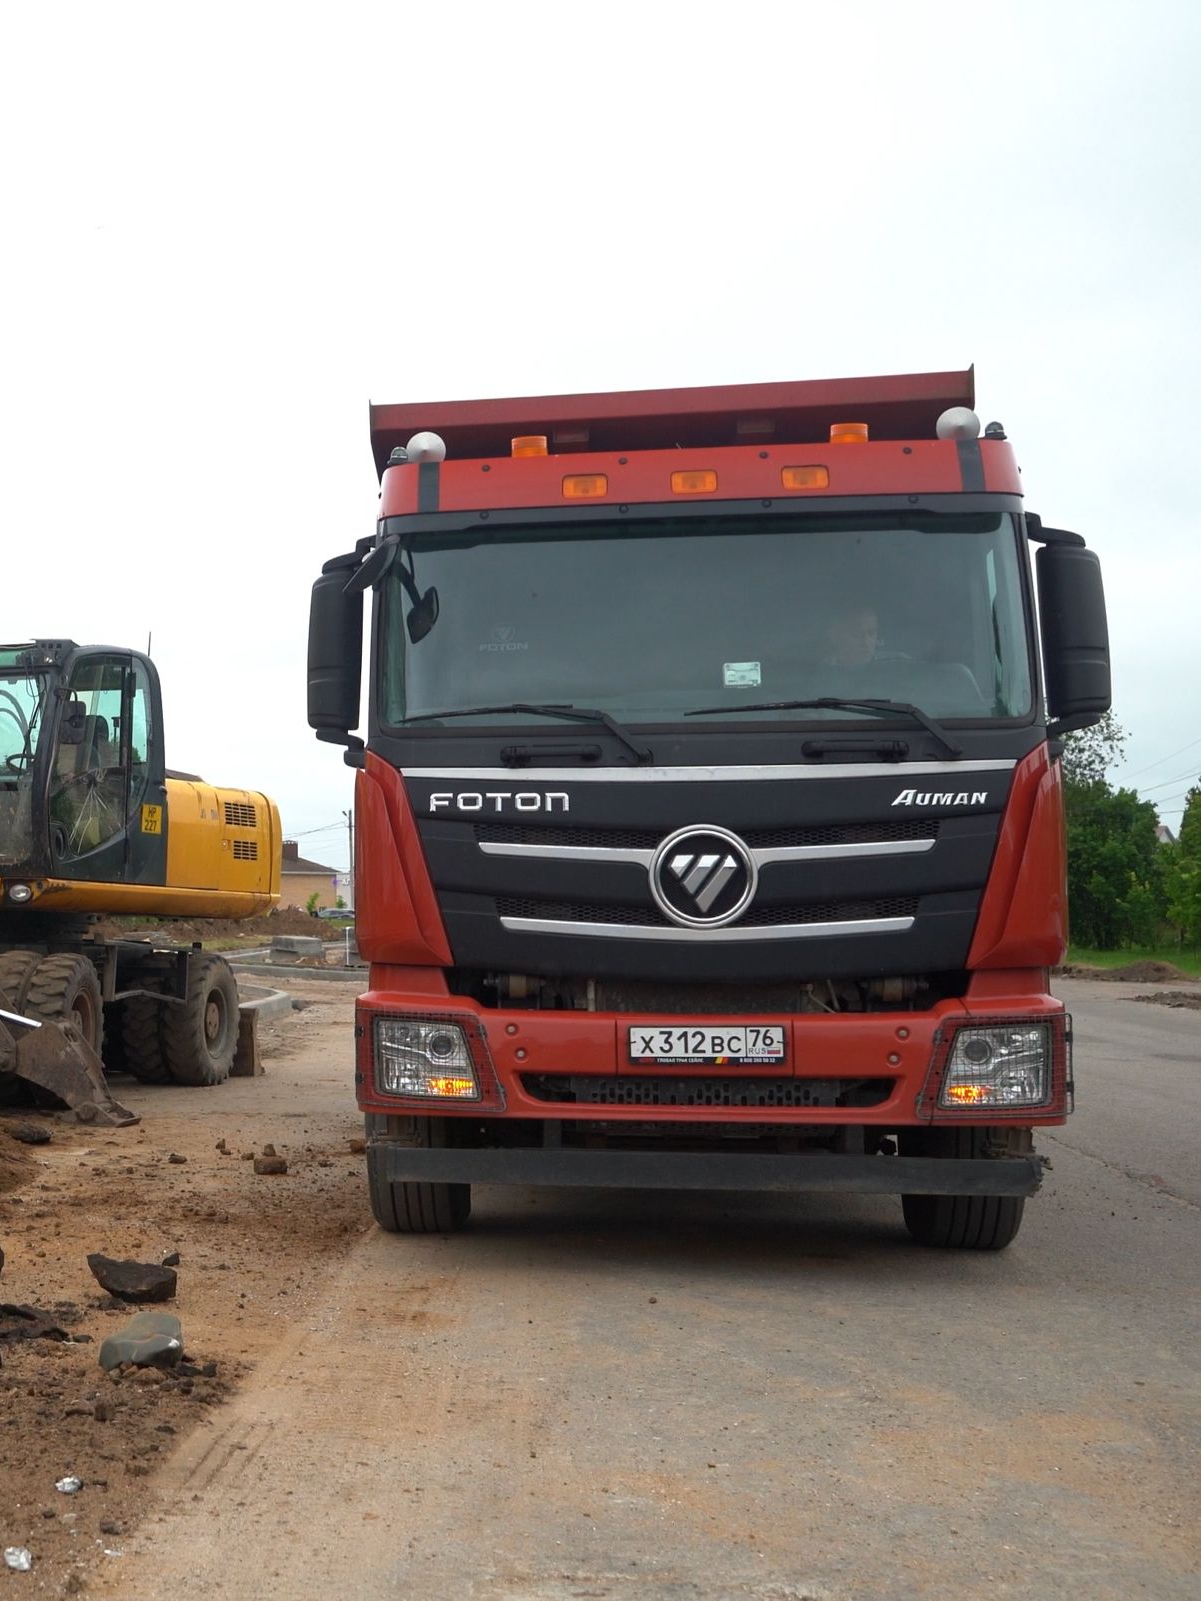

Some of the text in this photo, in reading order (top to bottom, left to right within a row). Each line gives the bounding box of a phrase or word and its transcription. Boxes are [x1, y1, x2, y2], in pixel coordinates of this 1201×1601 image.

[429, 792, 570, 812] FOTON
[890, 789, 989, 807] AUMAN
[748, 1029, 775, 1048] 76
[748, 1047, 767, 1055] RUS
